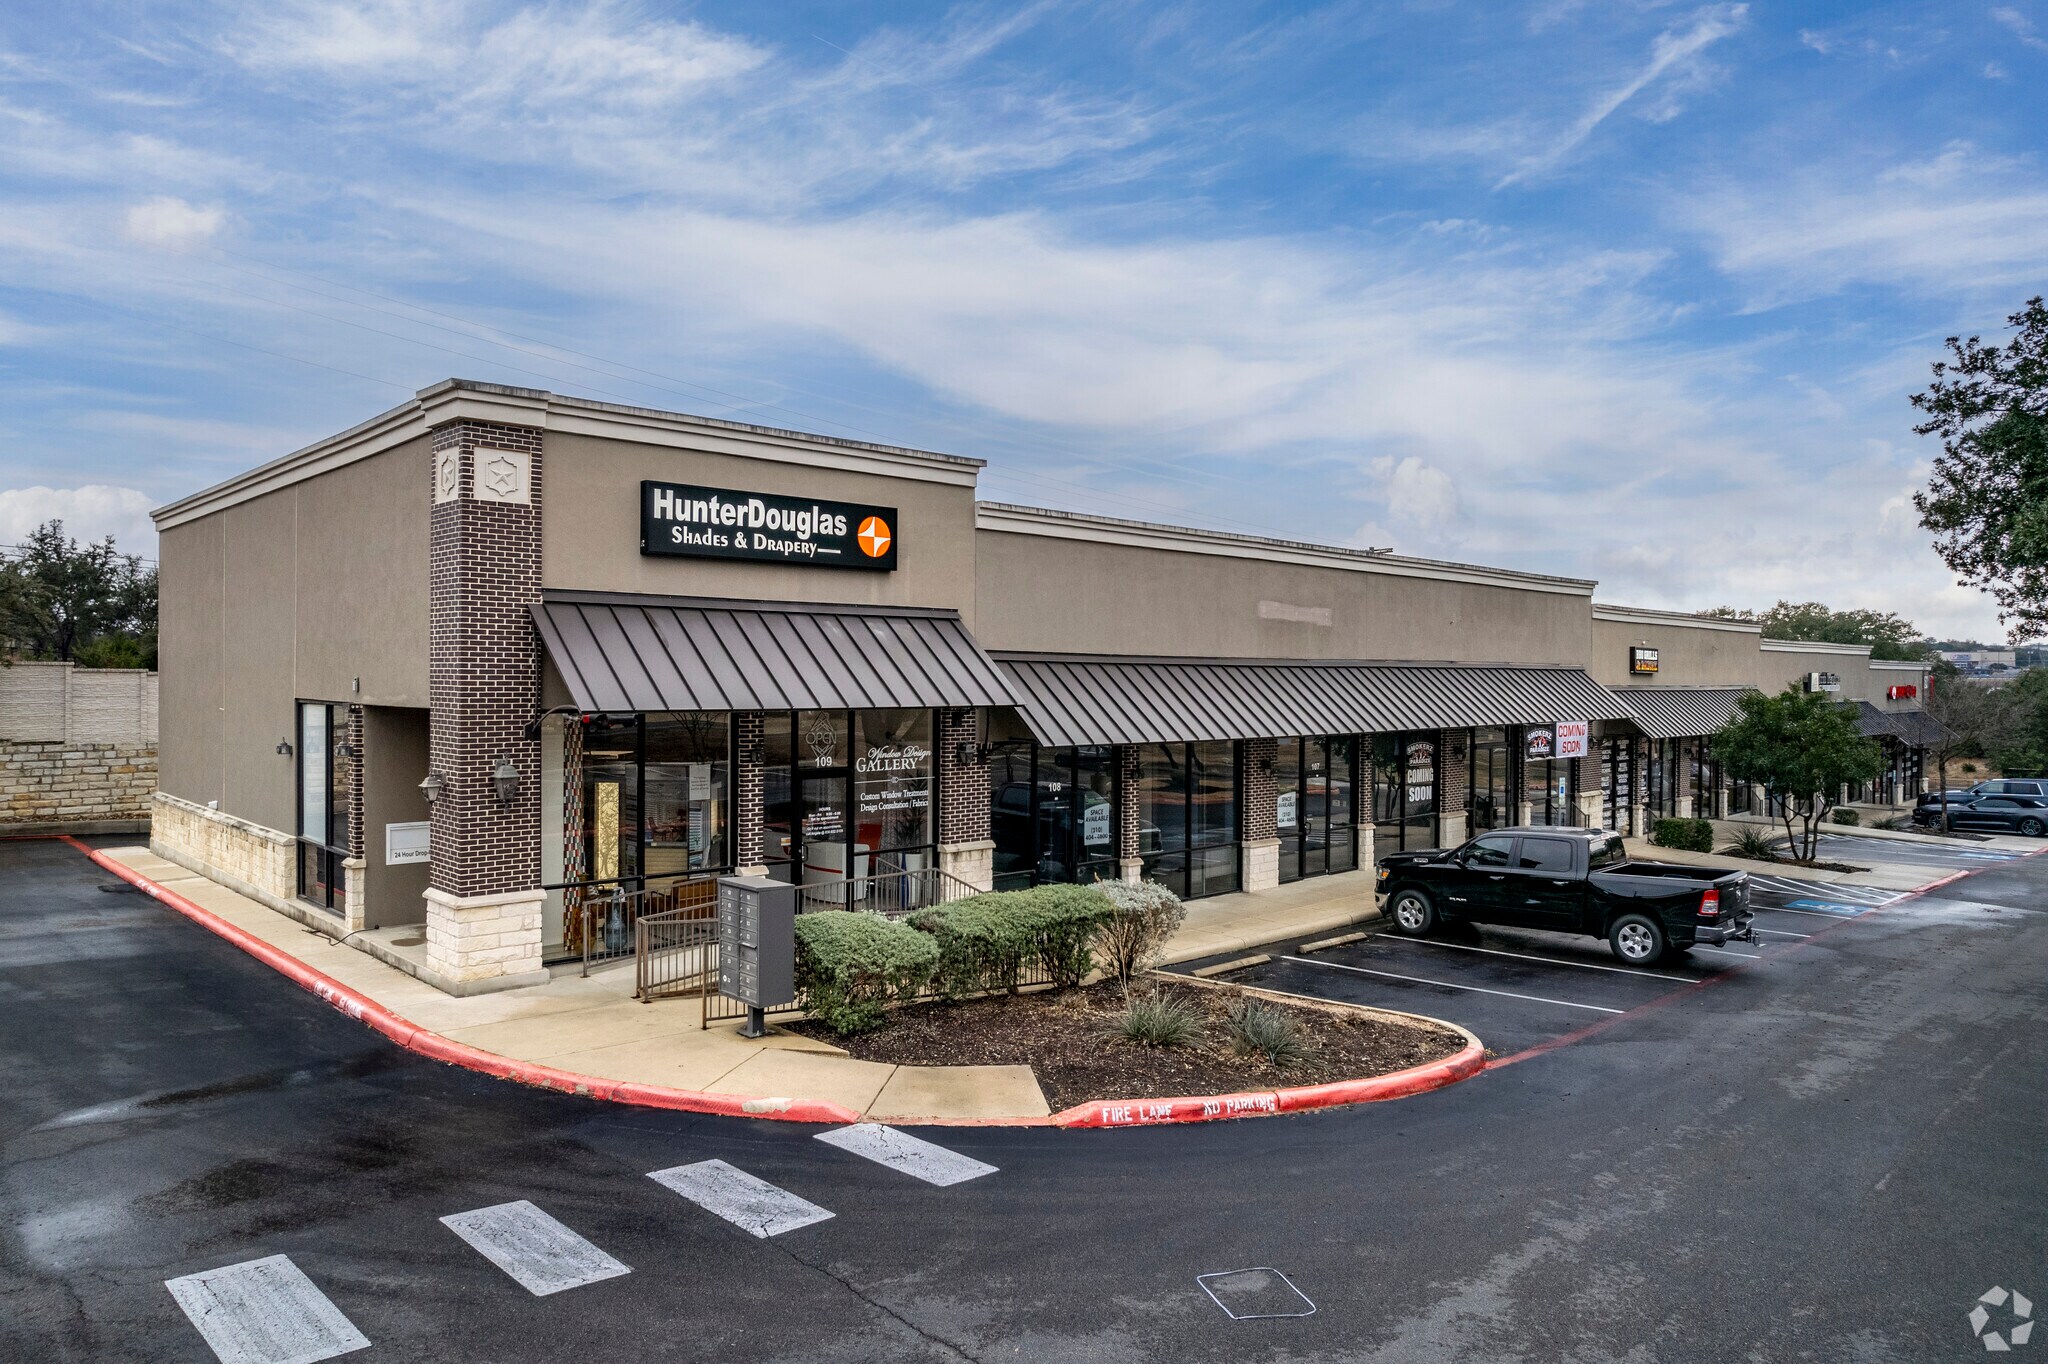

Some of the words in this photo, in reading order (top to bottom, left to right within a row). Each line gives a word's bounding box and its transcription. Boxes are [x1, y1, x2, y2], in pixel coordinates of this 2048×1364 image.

[734, 531, 748, 549] &
[1527, 730, 1552, 741] SMOKERZ
[1558, 724, 1586, 738] COMING
[805, 731, 837, 745] OPEN
[1407, 743, 1434, 754] SMOKERZ
[1562, 740, 1581, 753] SOON
[815, 756, 833, 767] 109
[867, 745, 902, 765] Window
[902, 745, 932, 761] Design
[856, 757, 918, 773] GALLERY
[1311, 762, 1320, 771] 107
[1407, 768, 1434, 784] COMING
[1048, 782, 1061, 792] 108
[860, 792, 880, 801] Custom
[880, 790, 903, 799] Window
[1409, 786, 1432, 802] SOON
[860, 802, 878, 813] Design
[878, 801, 909, 810] Consultation
[912, 799, 929, 807] Fabrics
[1090, 808, 1104, 816] SPACE
[1085, 814, 1109, 823] AVAILABLE
[1101, 1106, 1132, 1123] FIRE
[1139, 1104, 1173, 1121] LANE
[1203, 1100, 1220, 1116] NO
[1226, 1096, 1275, 1114] PARKING
